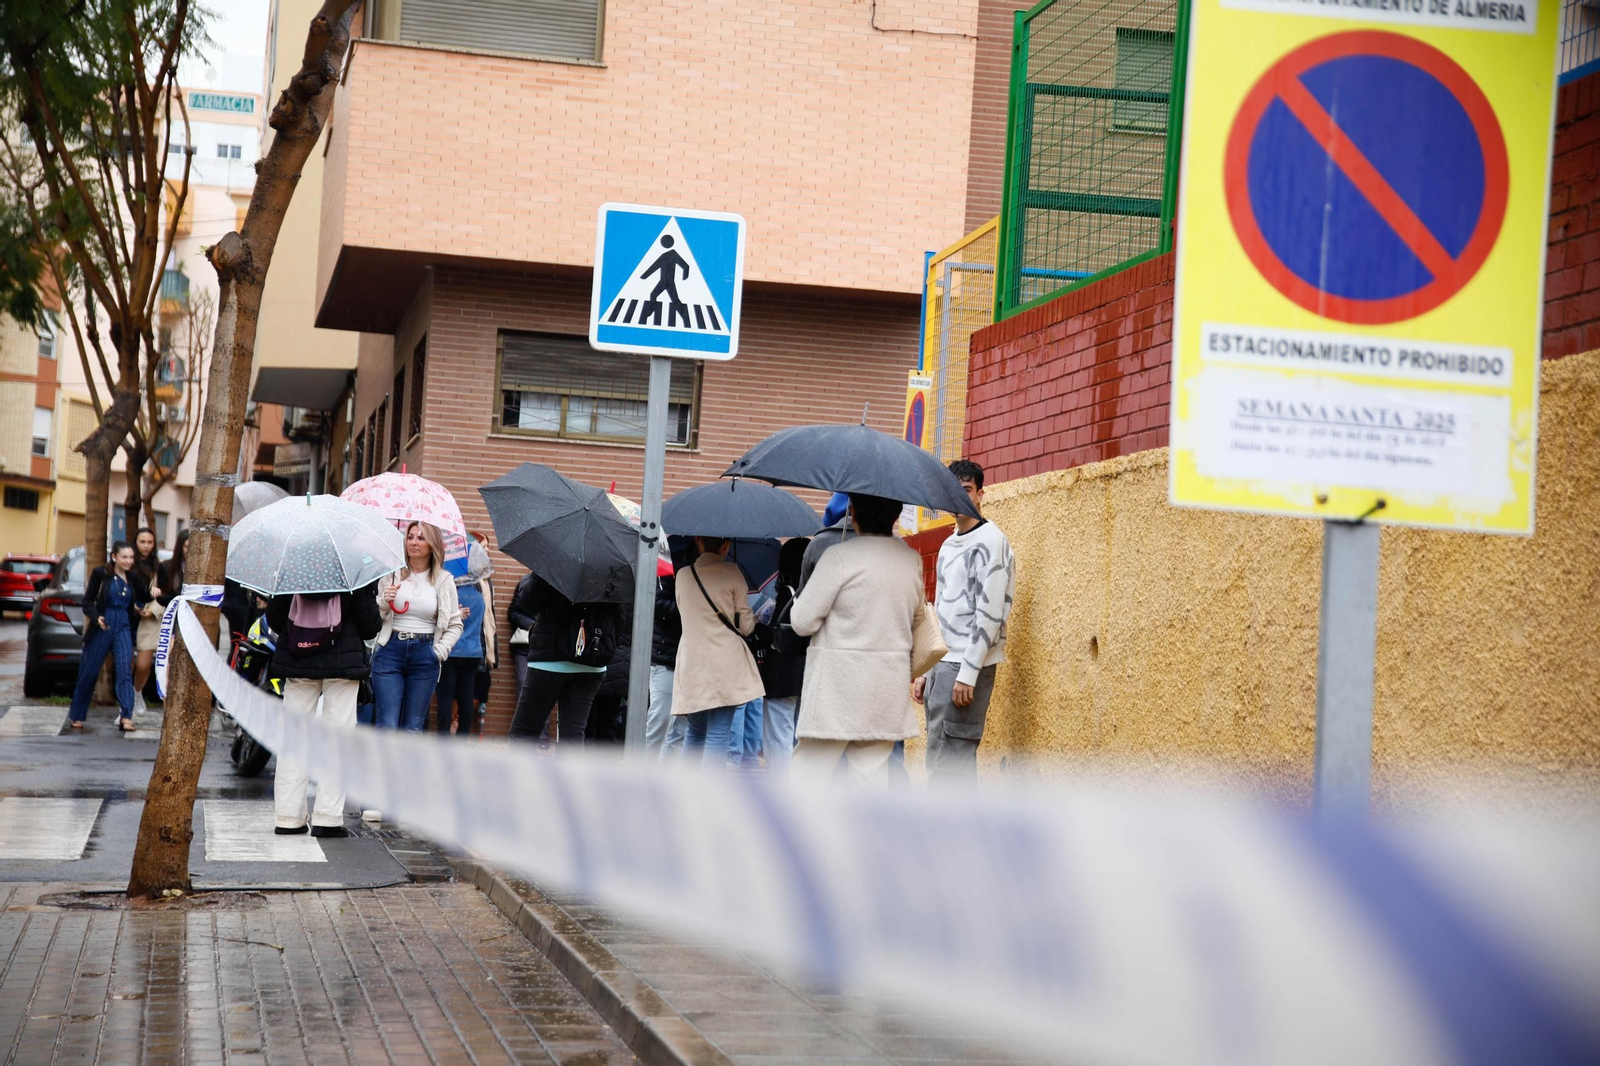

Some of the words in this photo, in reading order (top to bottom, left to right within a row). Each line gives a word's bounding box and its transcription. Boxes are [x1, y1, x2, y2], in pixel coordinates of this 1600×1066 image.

[1429, 0, 1449, 15] DE
[1455, 0, 1526, 22] ALMERIA
[190, 93, 253, 113] FARMACIA
[1209, 333, 1392, 366] ESTACIONAMIENTO
[1398, 349, 1505, 376] PROHIBIDO
[1237, 398, 1330, 420] SEMANA
[1334, 405, 1404, 427] SANTA
